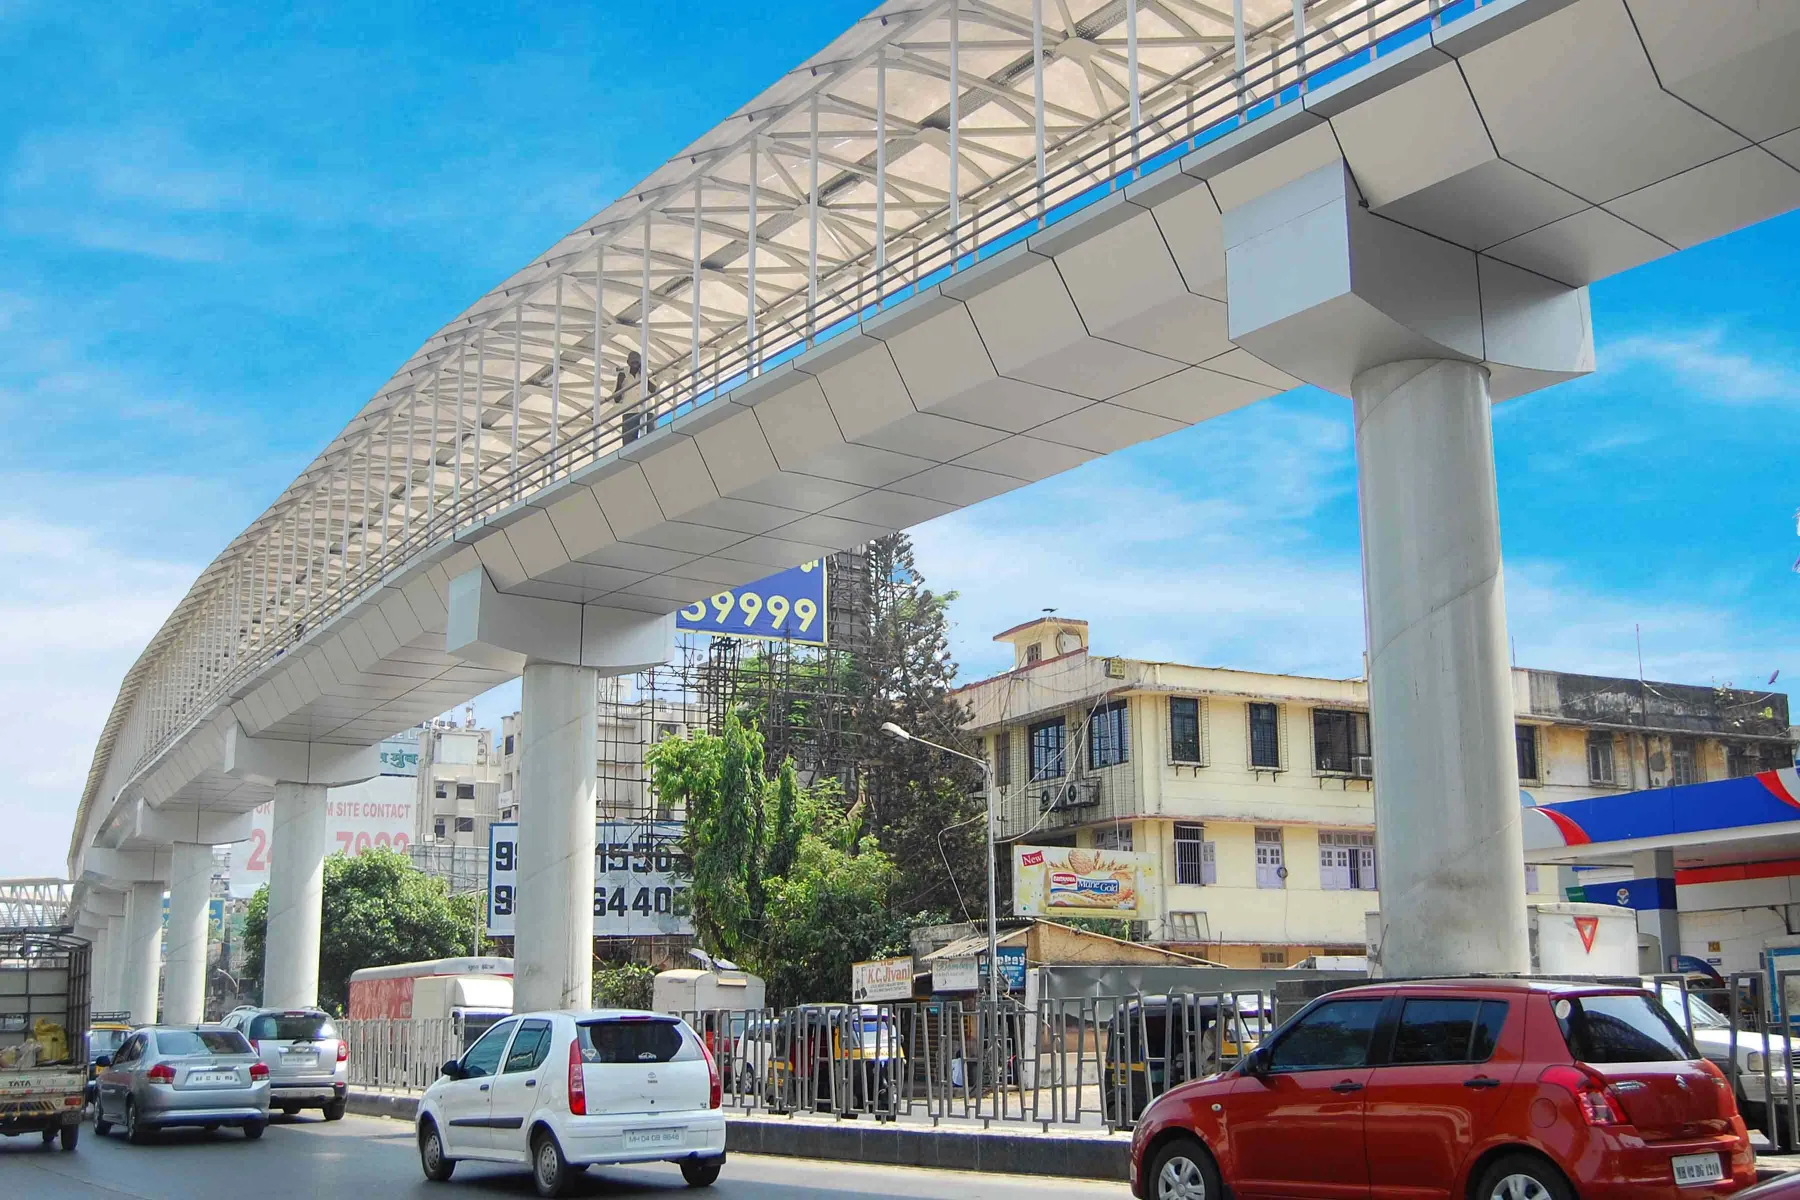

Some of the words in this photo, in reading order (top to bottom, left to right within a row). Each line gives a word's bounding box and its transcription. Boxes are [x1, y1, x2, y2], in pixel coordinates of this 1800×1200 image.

[336, 802, 360, 817] SITE
[363, 803, 411, 819] CONTACT
[1024, 854, 1042, 864] New
[1100, 882, 1118, 892] Gold
[8, 1080, 31, 1088] TATA
